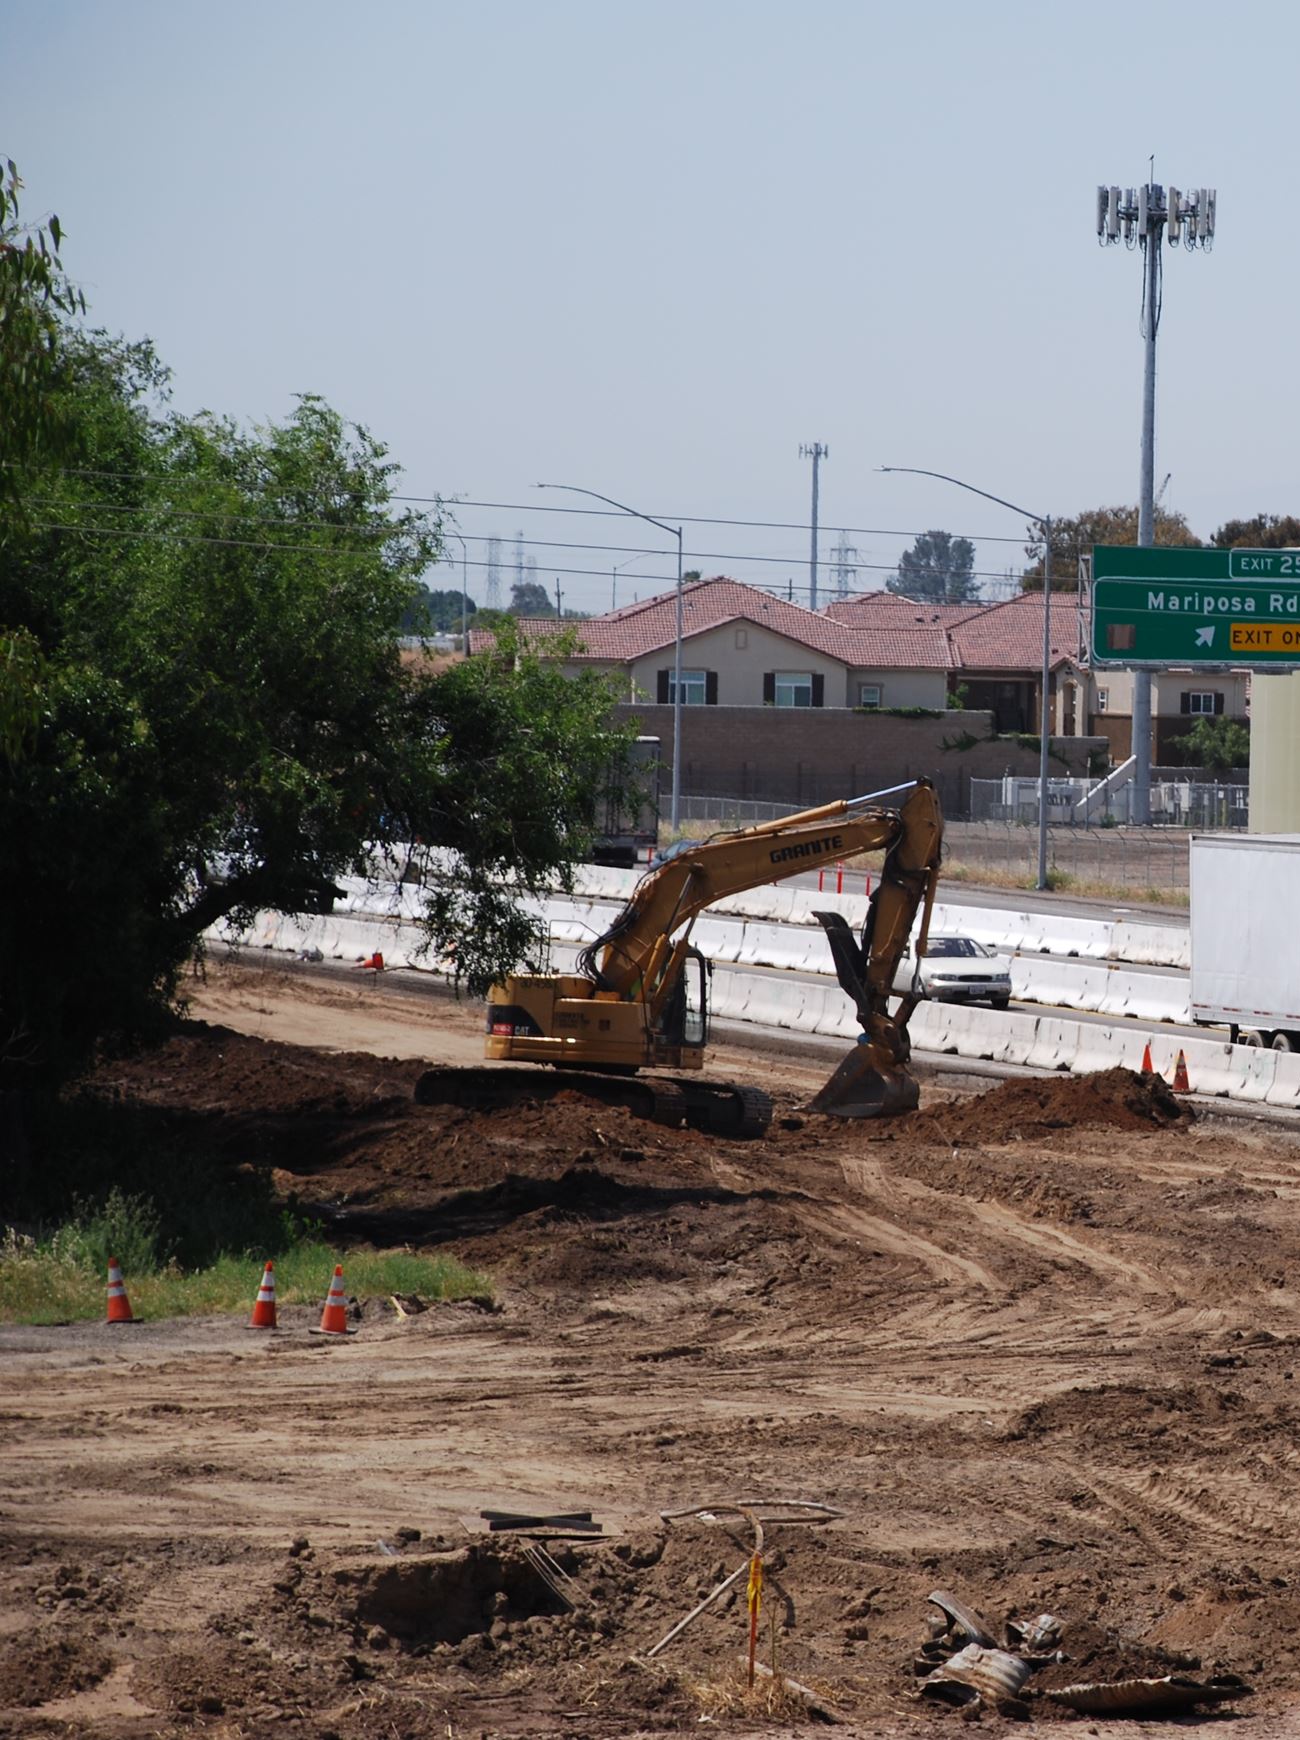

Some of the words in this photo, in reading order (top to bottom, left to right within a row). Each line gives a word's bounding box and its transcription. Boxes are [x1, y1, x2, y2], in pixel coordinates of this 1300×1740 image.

[1241, 558, 1273, 570] EXIT
[1148, 592, 1255, 614] Mariposa
[1269, 594, 1298, 612] Rd
[1232, 630, 1272, 644] EXIT
[769, 835, 843, 863] GRANITE
[514, 1025, 530, 1036] CAT
